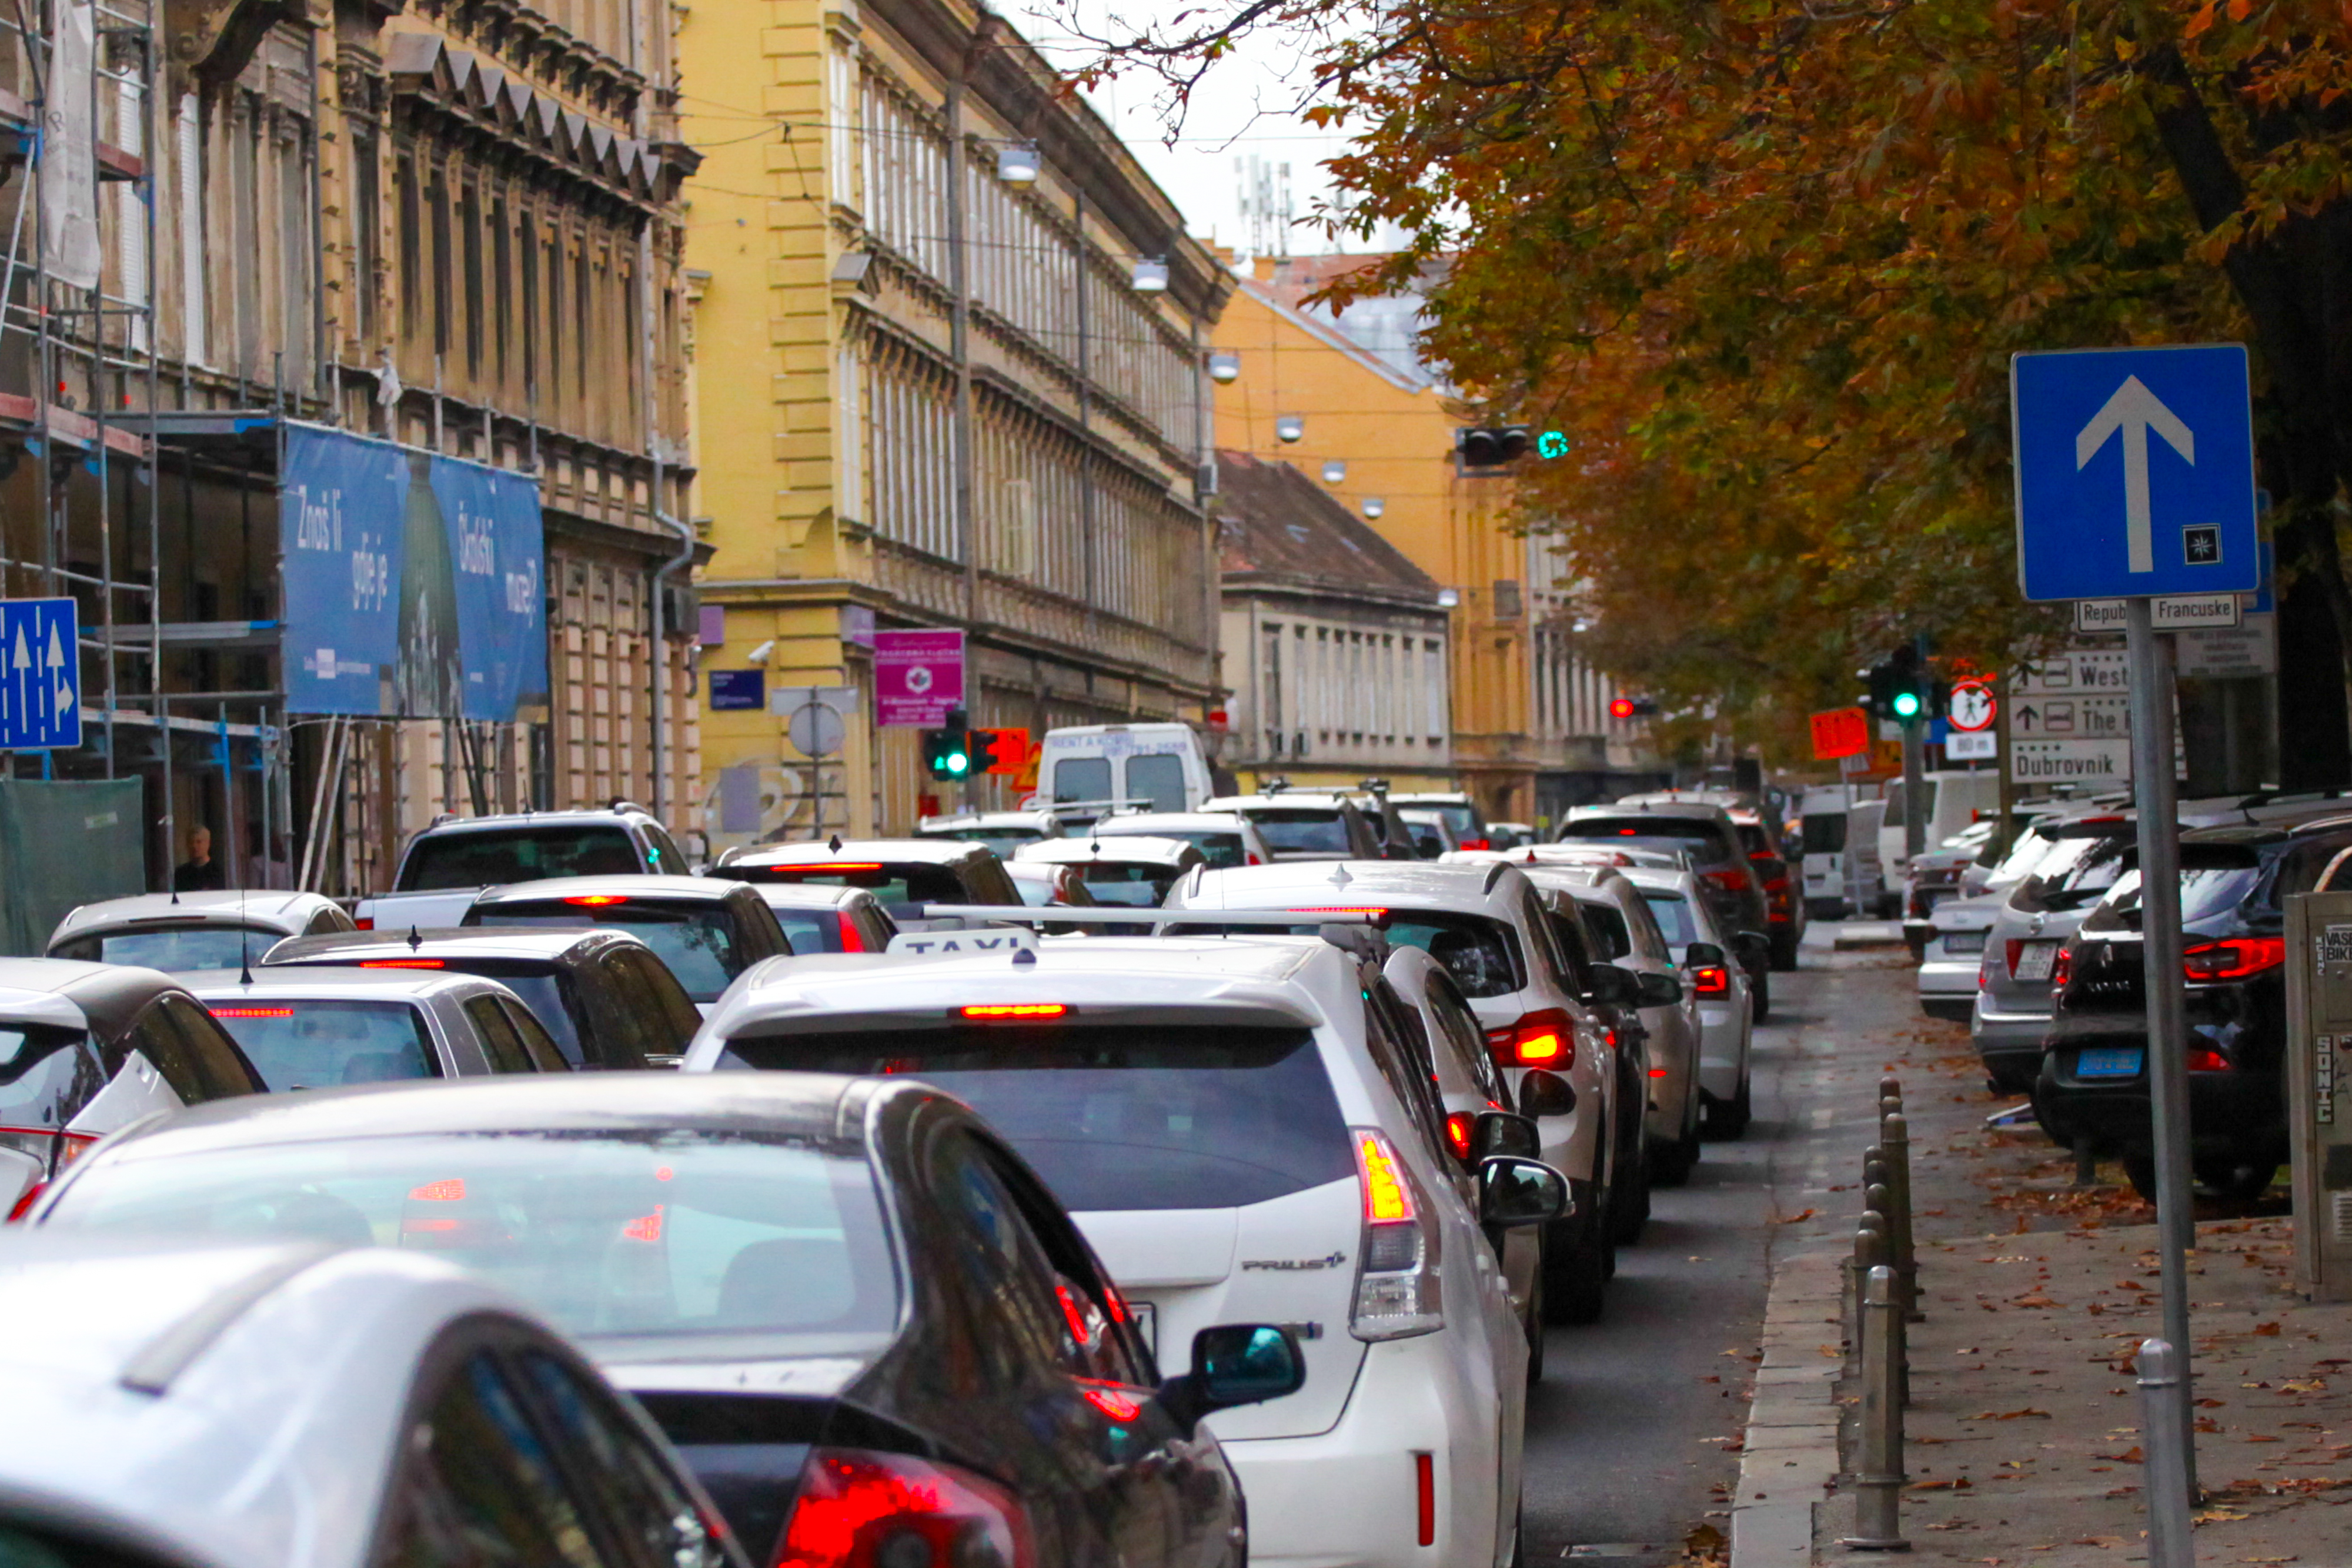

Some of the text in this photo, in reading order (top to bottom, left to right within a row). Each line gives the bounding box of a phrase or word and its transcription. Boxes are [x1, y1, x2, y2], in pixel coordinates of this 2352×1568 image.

[298, 484, 342, 551] Znaš li
[377, 534, 387, 611] je
[2159, 600, 2230, 618] Francuske
[2080, 666, 2128, 686] West
[2083, 710, 2116, 730] The
[2017, 754, 2114, 776] Dubrovnik
[2317, 1037, 2331, 1122] SONIC
